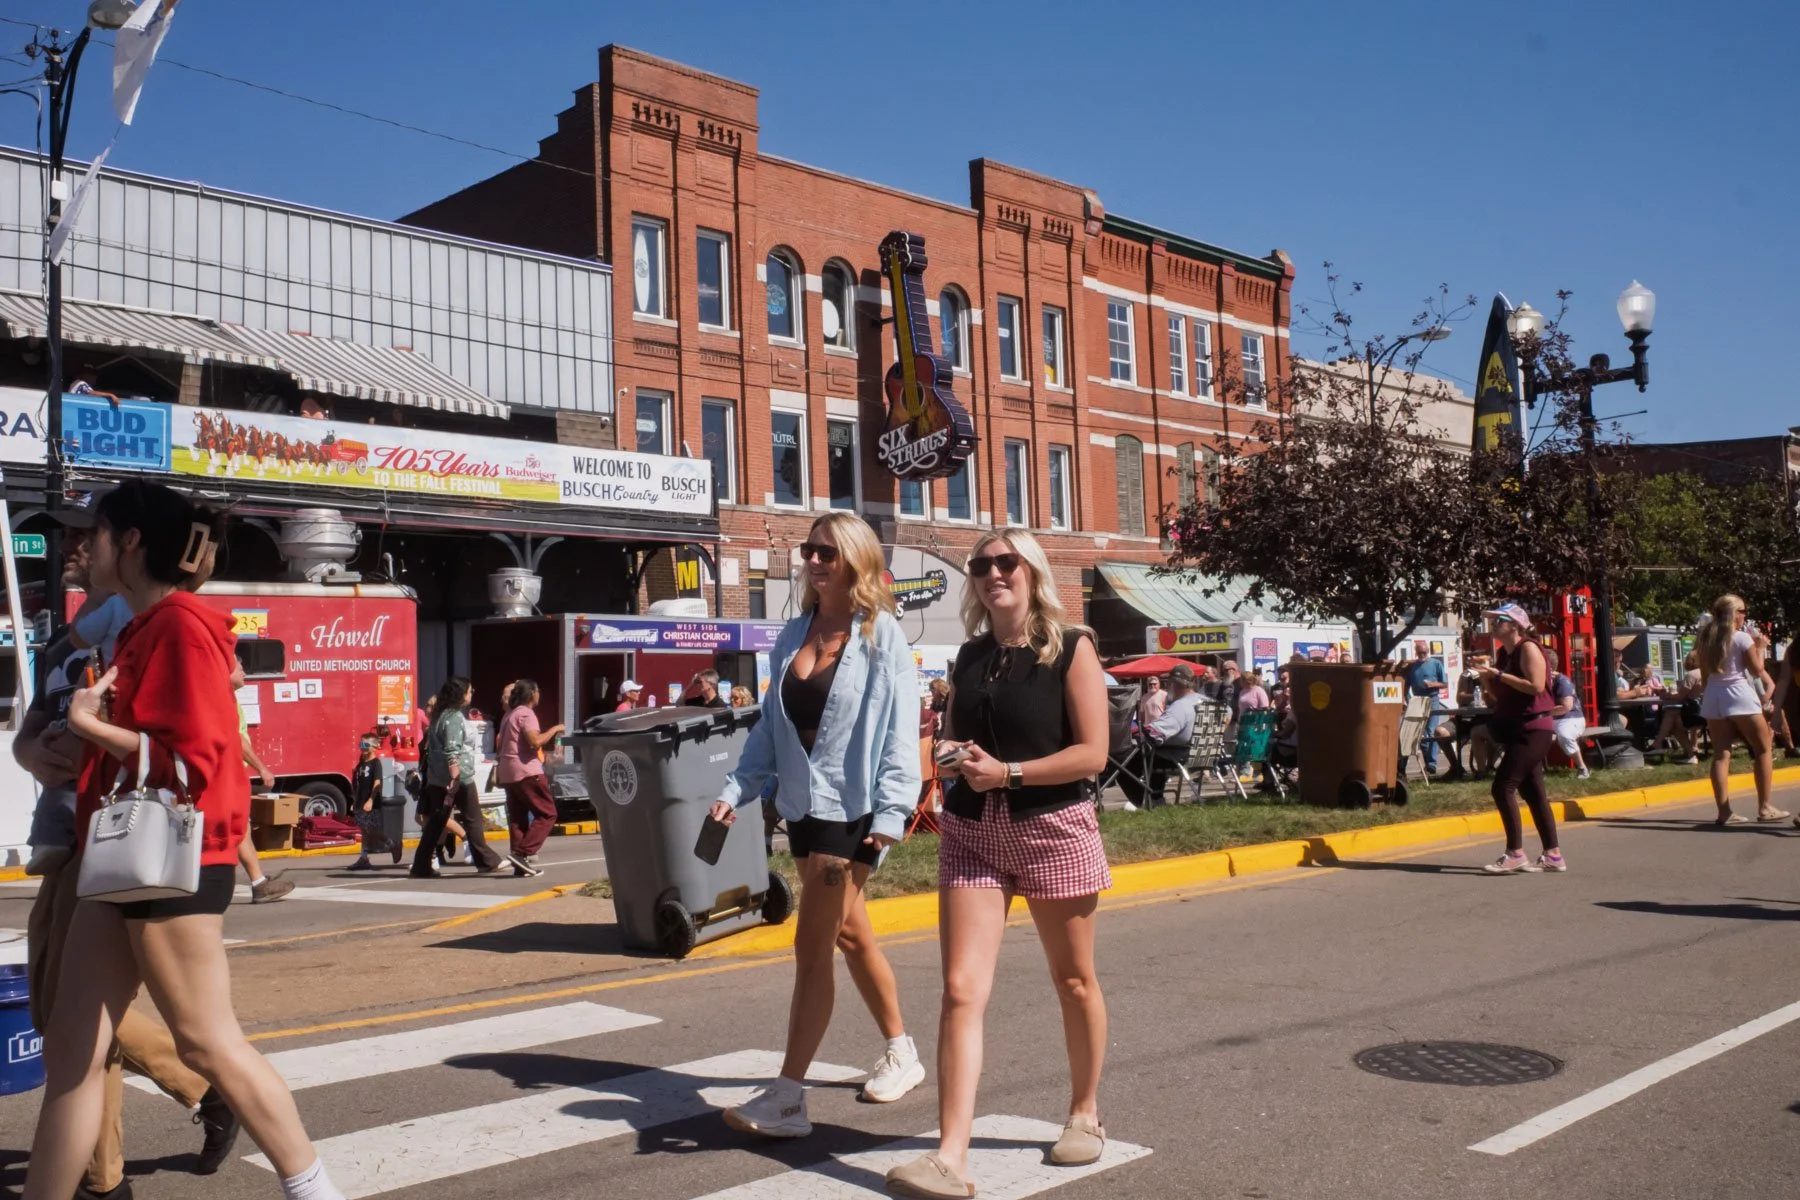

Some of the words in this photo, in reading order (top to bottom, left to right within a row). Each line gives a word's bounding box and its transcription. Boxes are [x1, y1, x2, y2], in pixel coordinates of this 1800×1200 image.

[77, 407, 146, 435] BUD
[64, 430, 159, 459] LIGHT
[878, 423, 910, 460] SIX
[888, 428, 947, 473] STRINGS
[374, 446, 434, 473] 105
[433, 449, 500, 478] Years
[573, 456, 634, 479] WELCOME
[637, 462, 651, 480] TO
[373, 471, 390, 486] TO
[393, 472, 417, 488] THE
[420, 474, 447, 491] FALL
[450, 476, 501, 495] FESTIVAL
[505, 466, 558, 480] Budweiser
[562, 480, 611, 500] BUSCH
[613, 485, 659, 504] Country
[661, 475, 706, 494] BUSCH
[671, 492, 697, 501] LIGHT
[13, 537, 29, 553] in
[31, 540, 42, 549] St
[240, 616, 258, 631] 35
[310, 615, 390, 648] Howell
[663, 631, 700, 640] CHRISTIAN
[702, 632, 731, 641] CHURCH
[1179, 631, 1228, 646] CIDER
[290, 660, 322, 672] UNITED
[324, 660, 373, 671] METHODIST
[375, 660, 411, 671] CHURCH
[1377, 686, 1398, 698] WM
